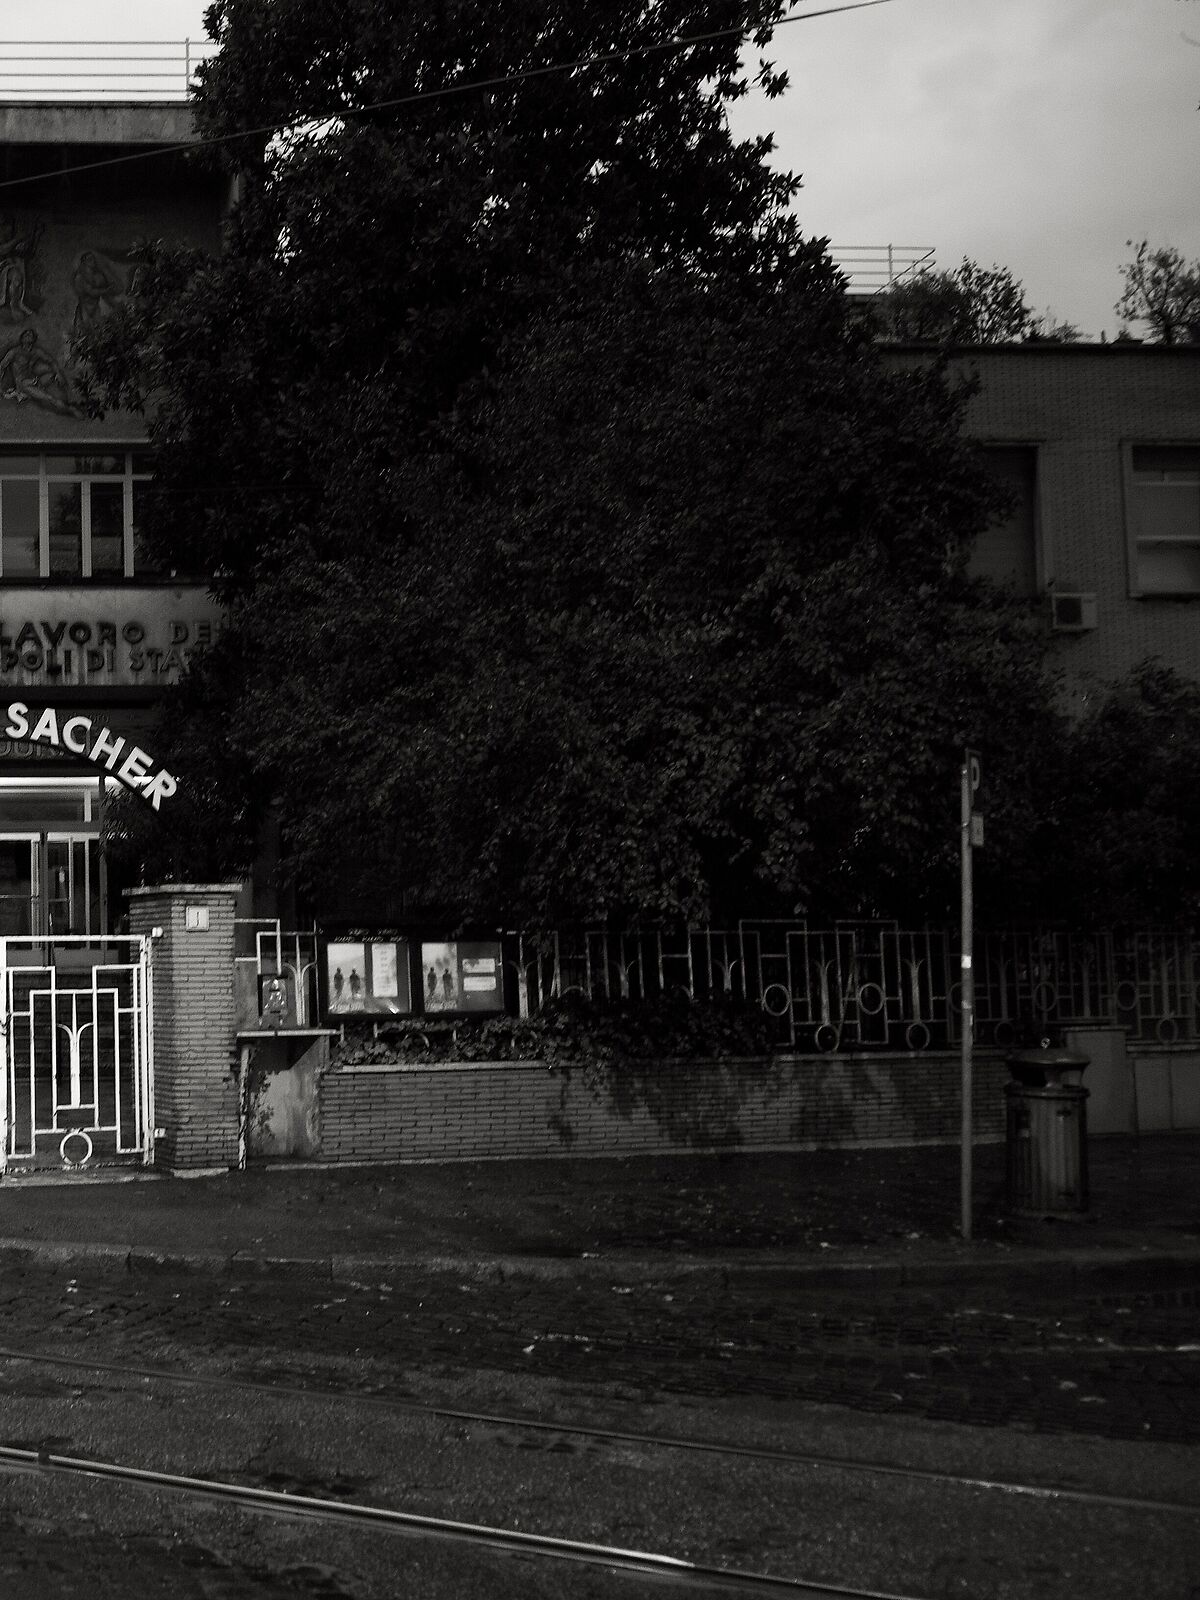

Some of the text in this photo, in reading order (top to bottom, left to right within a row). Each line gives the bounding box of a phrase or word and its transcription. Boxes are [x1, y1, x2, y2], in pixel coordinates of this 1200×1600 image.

[86, 649, 115, 674] DI
[129, 648, 202, 674] STAT
[4, 701, 179, 812] SACHER
